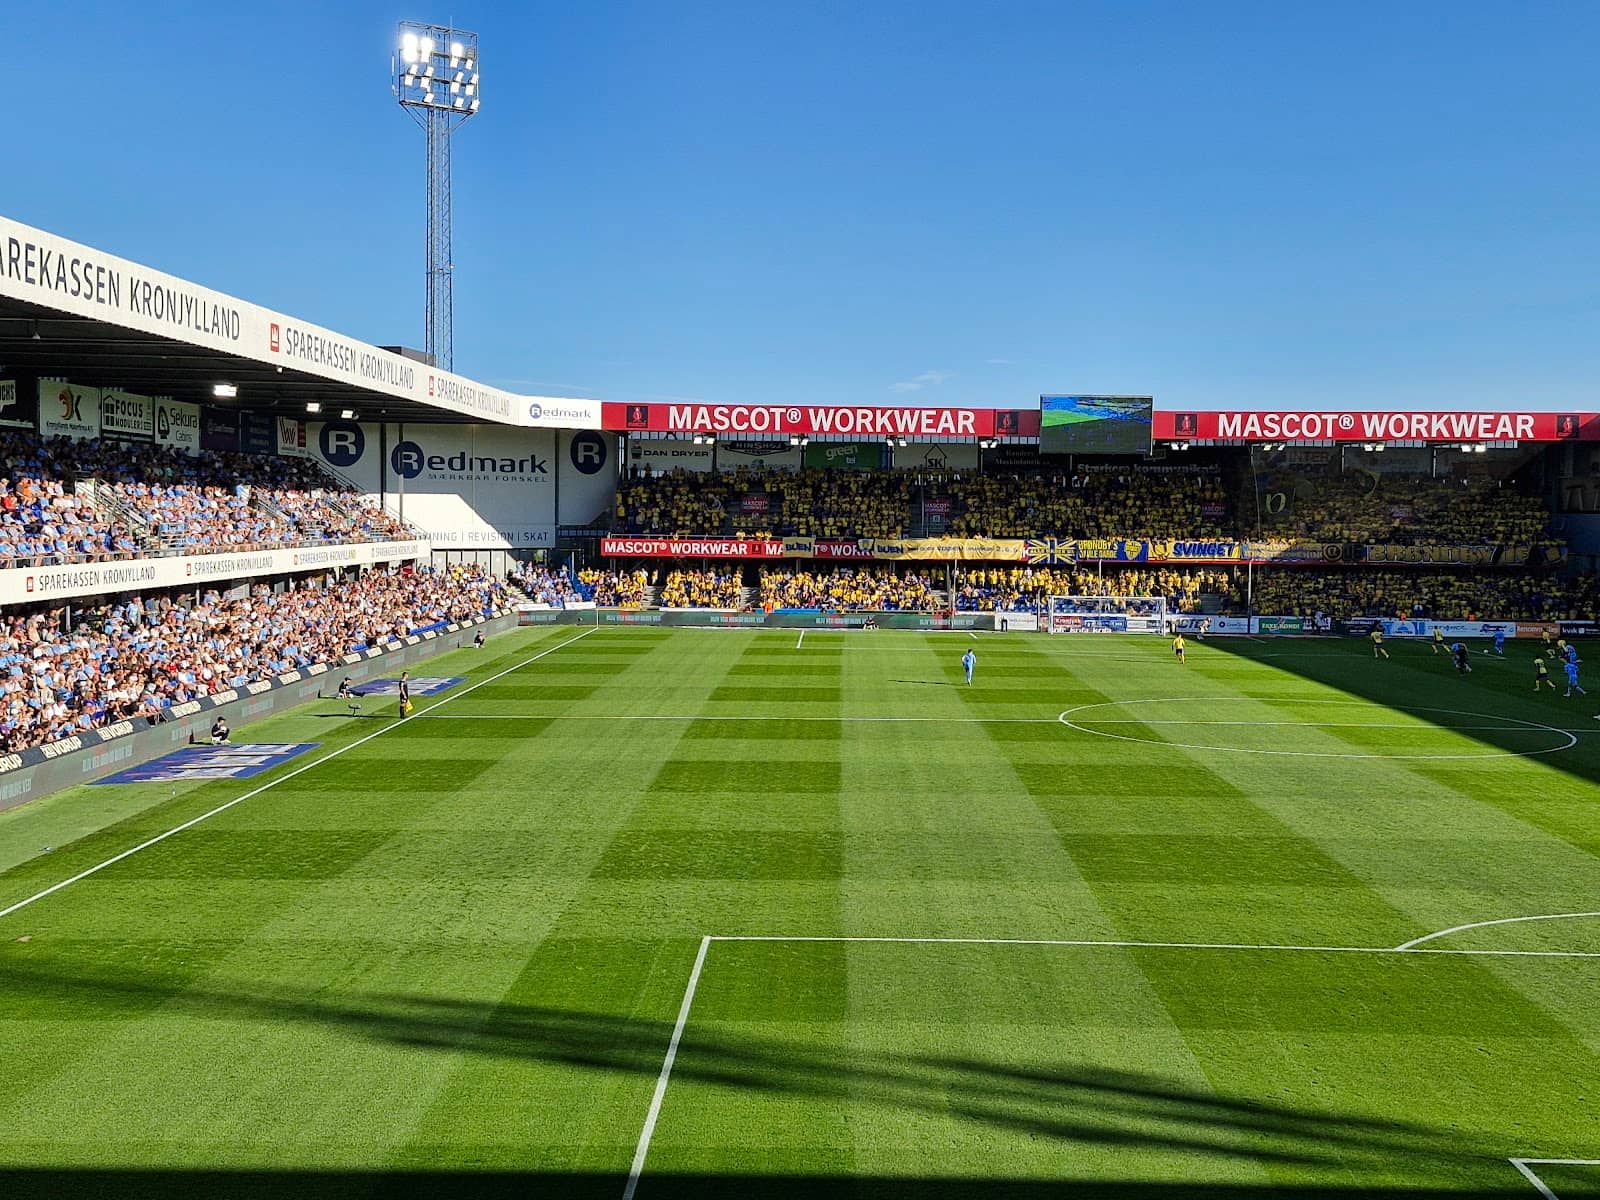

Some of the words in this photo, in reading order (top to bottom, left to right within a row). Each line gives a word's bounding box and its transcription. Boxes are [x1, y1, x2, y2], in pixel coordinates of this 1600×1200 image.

[130, 276, 241, 341] KRONJYLLAND
[286, 327, 356, 374] SPAREKASSEN
[360, 353, 414, 390] KRONJYLLAND
[437, 378, 477, 408] SPAREKASSEN
[478, 390, 510, 416] KRONJYLLAND
[115, 399, 143, 418] FOCUS
[170, 407, 198, 428] Sekura
[529, 404, 592, 418] Redmark
[808, 408, 976, 434] WORKWEAR
[1361, 413, 1535, 438] WORKWEAR
[328, 430, 356, 455] R
[397, 450, 548, 474] Redmark
[577, 442, 600, 464] R
[826, 446, 858, 460] green
[928, 458, 943, 468] SK
[495, 475, 548, 483] FORSKEL
[468, 532, 514, 541] REVISION
[523, 532, 548, 541] SKAT
[300, 551, 329, 564] SPAREKASSEN
[669, 542, 748, 555] WORKWEAR
[1173, 542, 1235, 557] SVINGET
[194, 558, 235, 575] SPAREKASSEN
[237, 556, 273, 571] KRONJYLLAND
[38, 570, 100, 591] SPAREKASSEN
[103, 565, 156, 585] KRONJYLLAND
